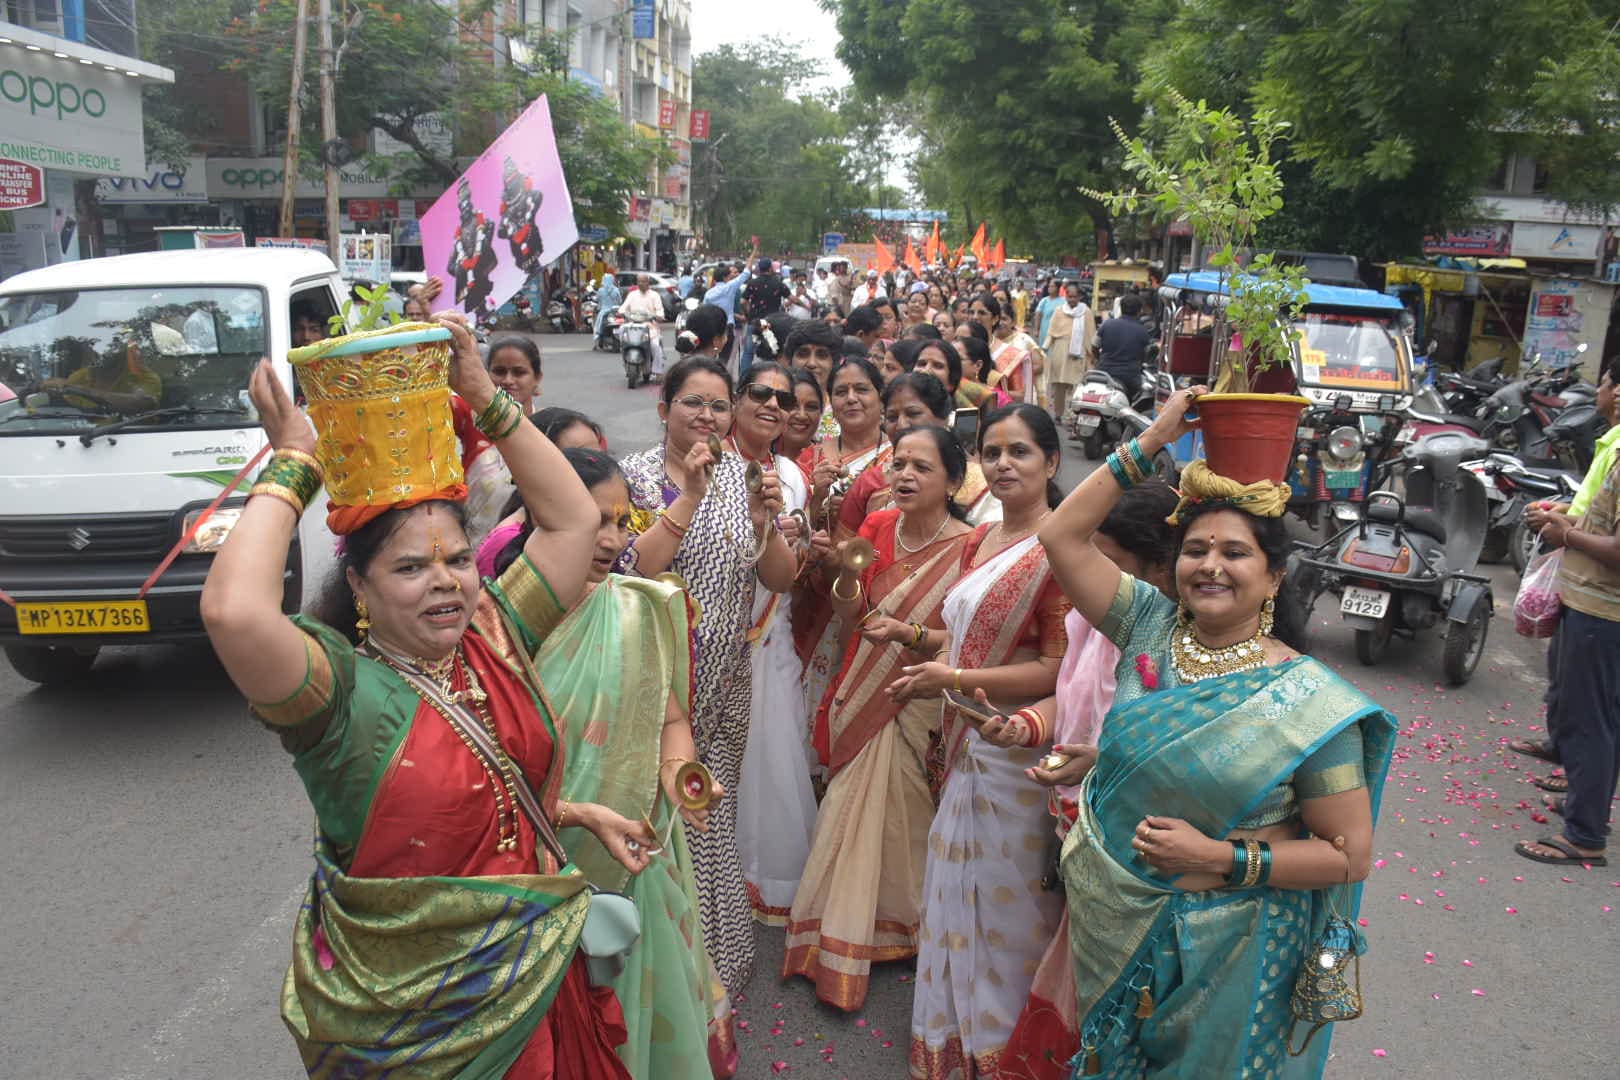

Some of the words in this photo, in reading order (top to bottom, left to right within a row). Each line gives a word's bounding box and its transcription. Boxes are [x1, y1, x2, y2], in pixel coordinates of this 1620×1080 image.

[1, 70, 106, 120] oppo
[0, 143, 75, 165] ONNECTING
[79, 152, 121, 171] PEOPLE
[0, 164, 26, 172] RNET
[0, 172, 33, 180] NLINE
[1343, 599, 1383, 616] 9129
[29, 608, 144, 628] MP13ZK7366
